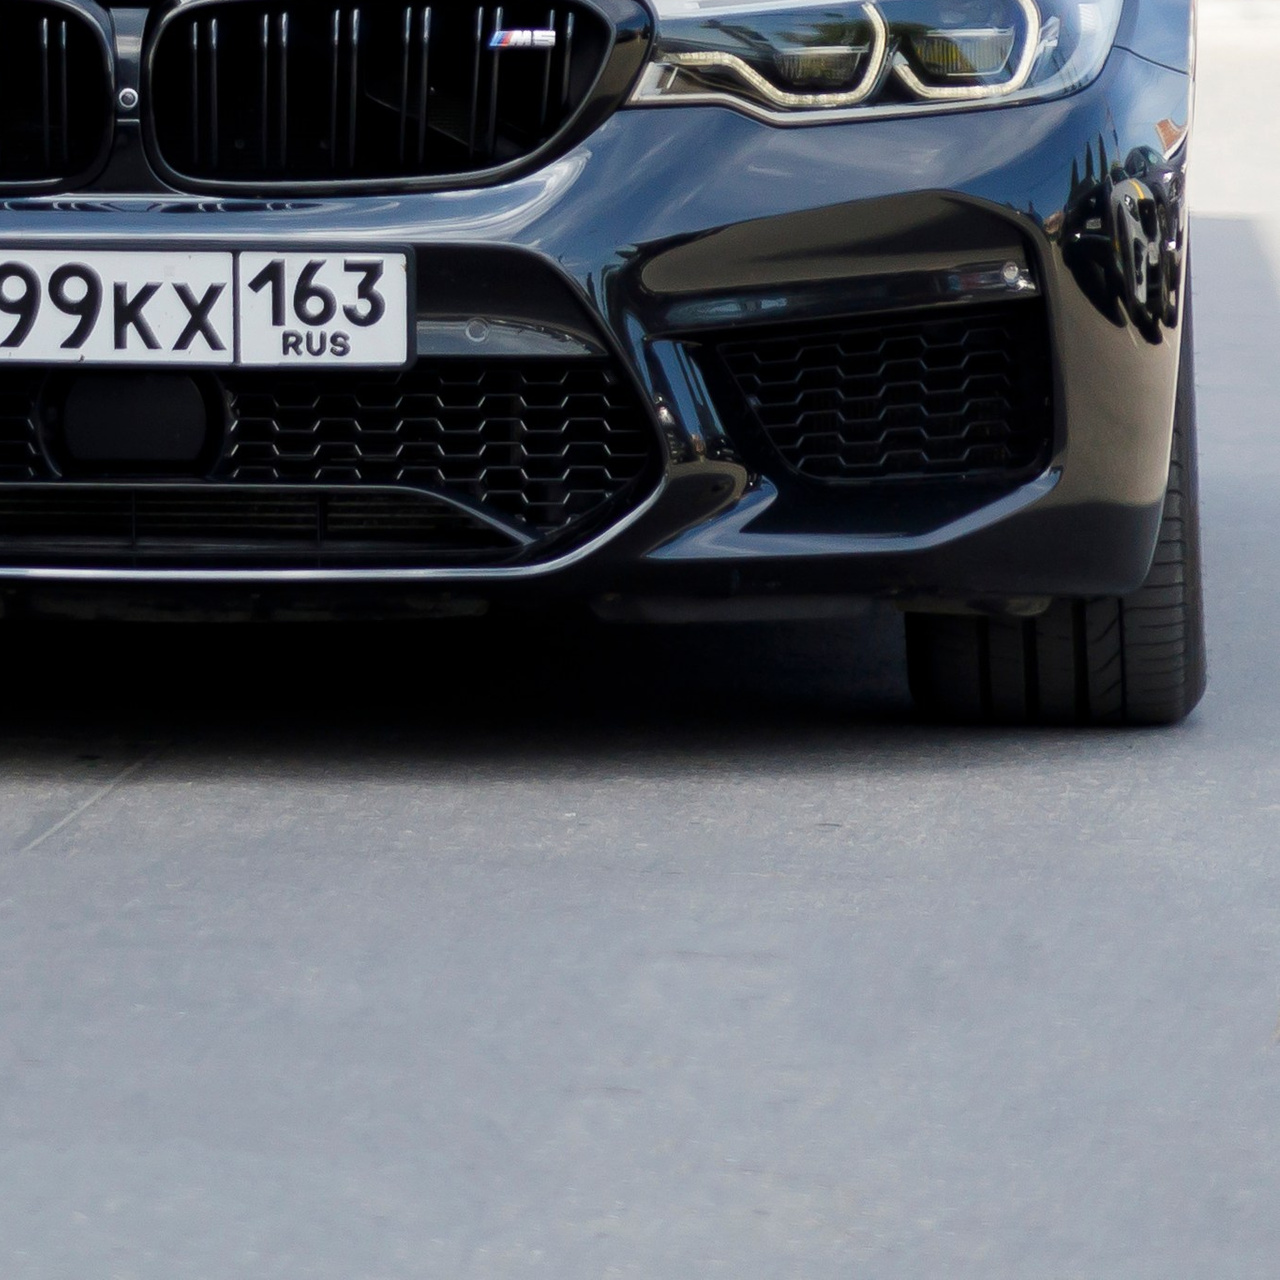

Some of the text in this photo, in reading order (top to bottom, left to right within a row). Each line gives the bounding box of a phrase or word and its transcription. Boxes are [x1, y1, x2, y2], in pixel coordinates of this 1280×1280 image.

[504, 29, 556, 48] M5
[247, 259, 386, 328] 163
[281, 330, 351, 357] RUS
